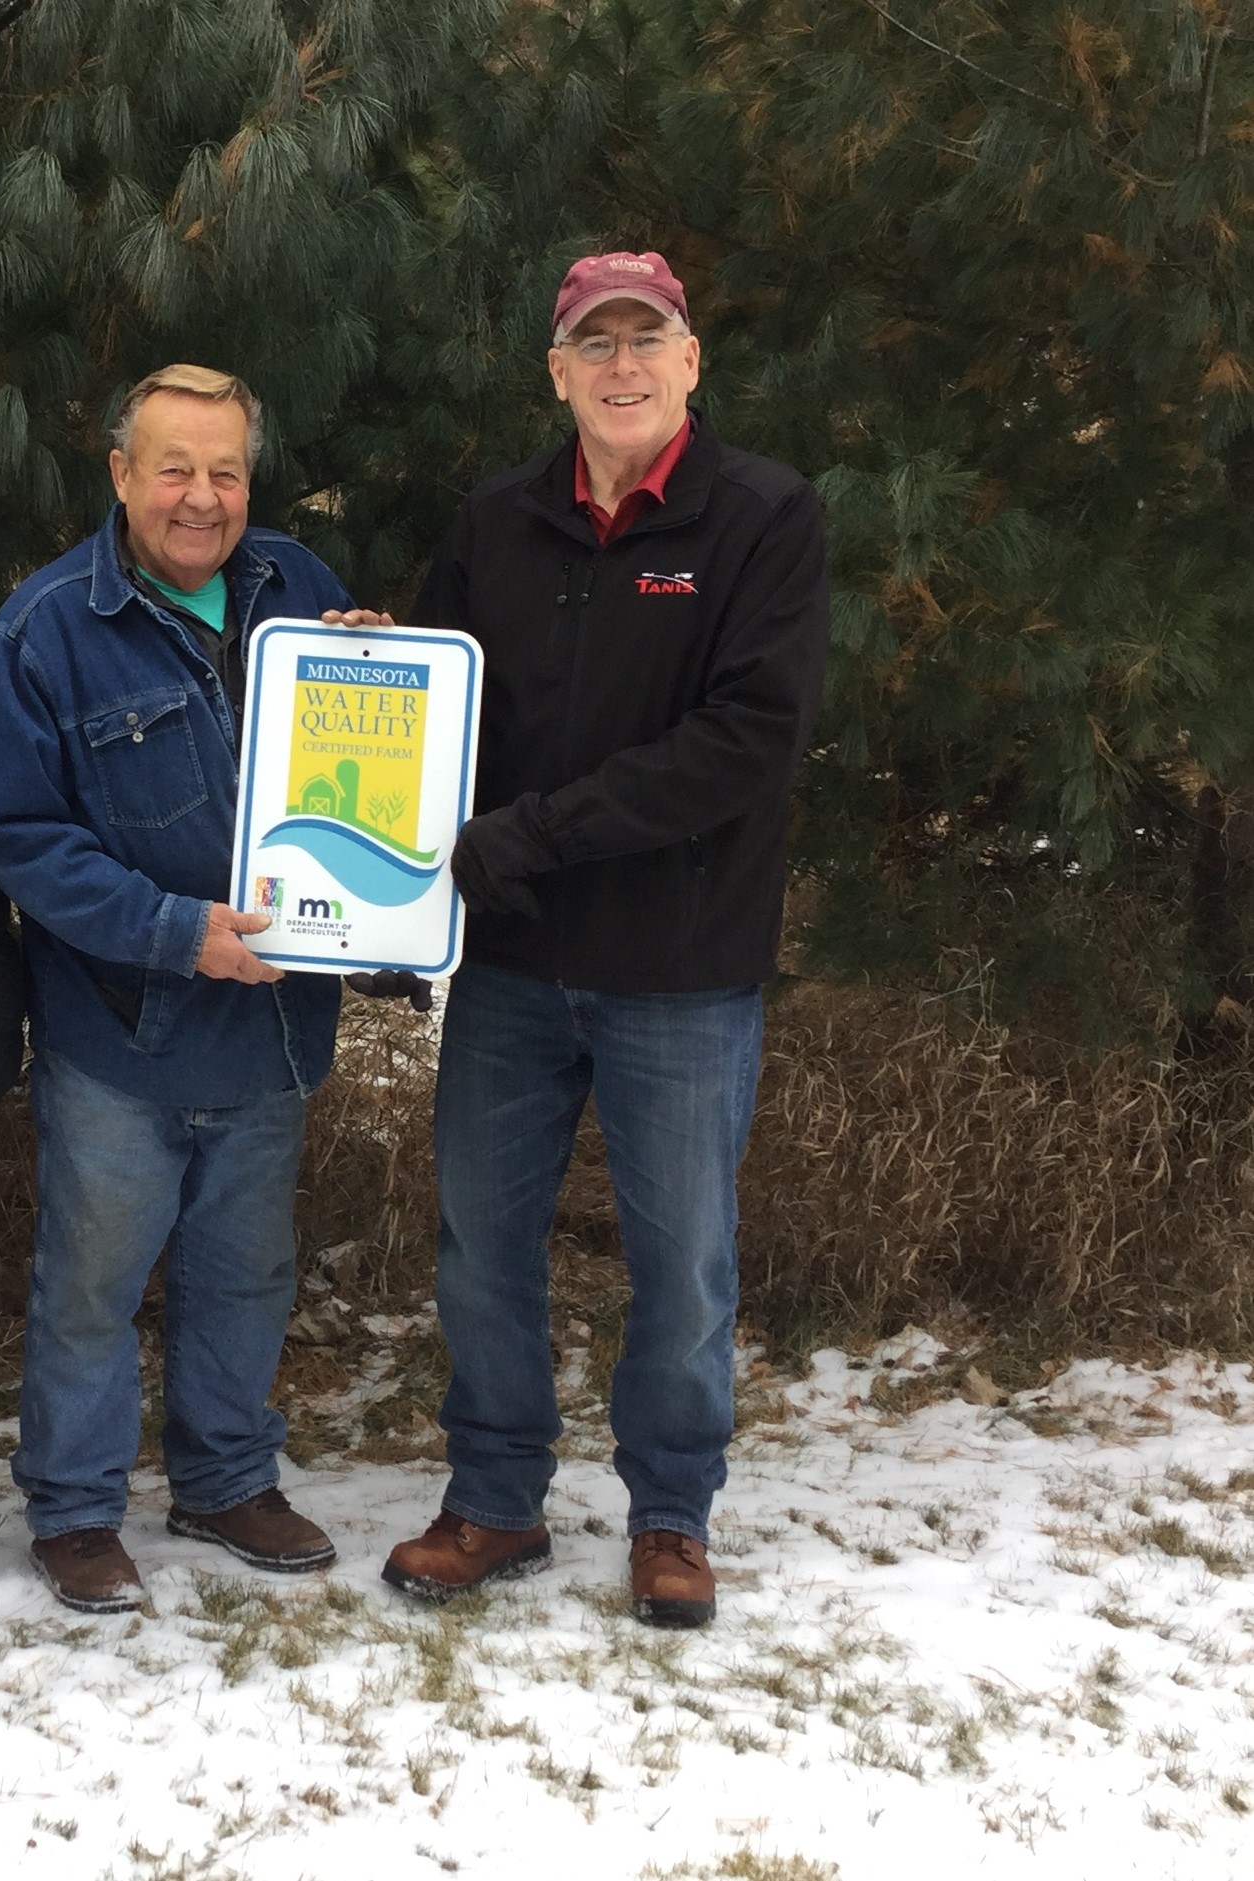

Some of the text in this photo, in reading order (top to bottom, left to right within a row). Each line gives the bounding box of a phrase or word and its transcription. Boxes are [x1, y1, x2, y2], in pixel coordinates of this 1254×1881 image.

[634, 579, 695, 594] TANIS
[306, 663, 420, 687] MINNESOTA
[304, 687, 418, 715] WATER
[301, 710, 418, 738] QUALITY
[302, 740, 413, 760] CERTIFIED FARM
[286, 919, 339, 930] DEPARTMENT
[290, 927, 347, 938] AGRICULTURE
